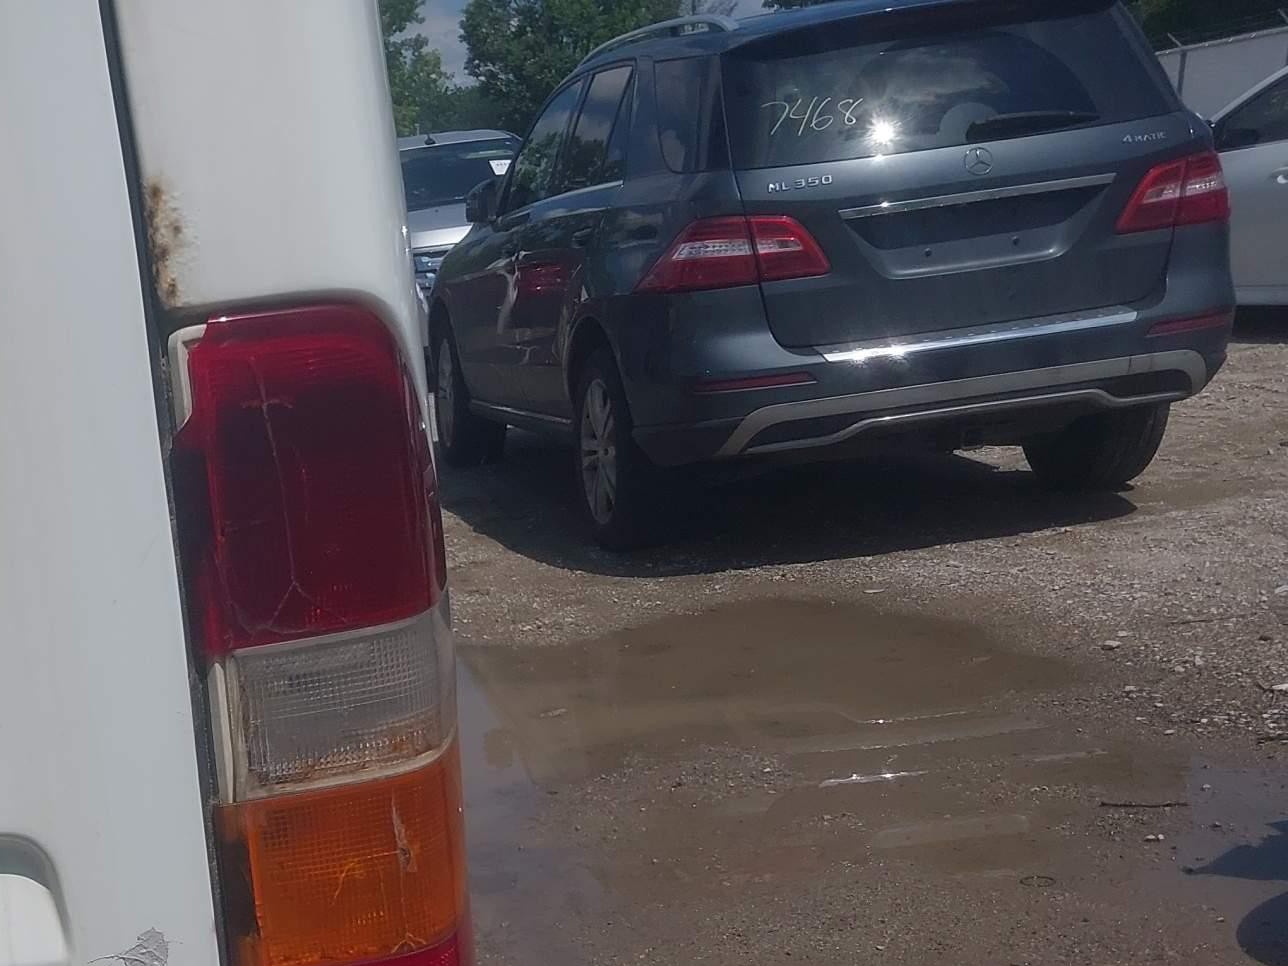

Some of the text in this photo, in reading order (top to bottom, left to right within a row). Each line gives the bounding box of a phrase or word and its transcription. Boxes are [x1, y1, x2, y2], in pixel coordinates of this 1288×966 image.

[760, 96, 864, 136] 7468
[768, 174, 833, 193] ML 350
